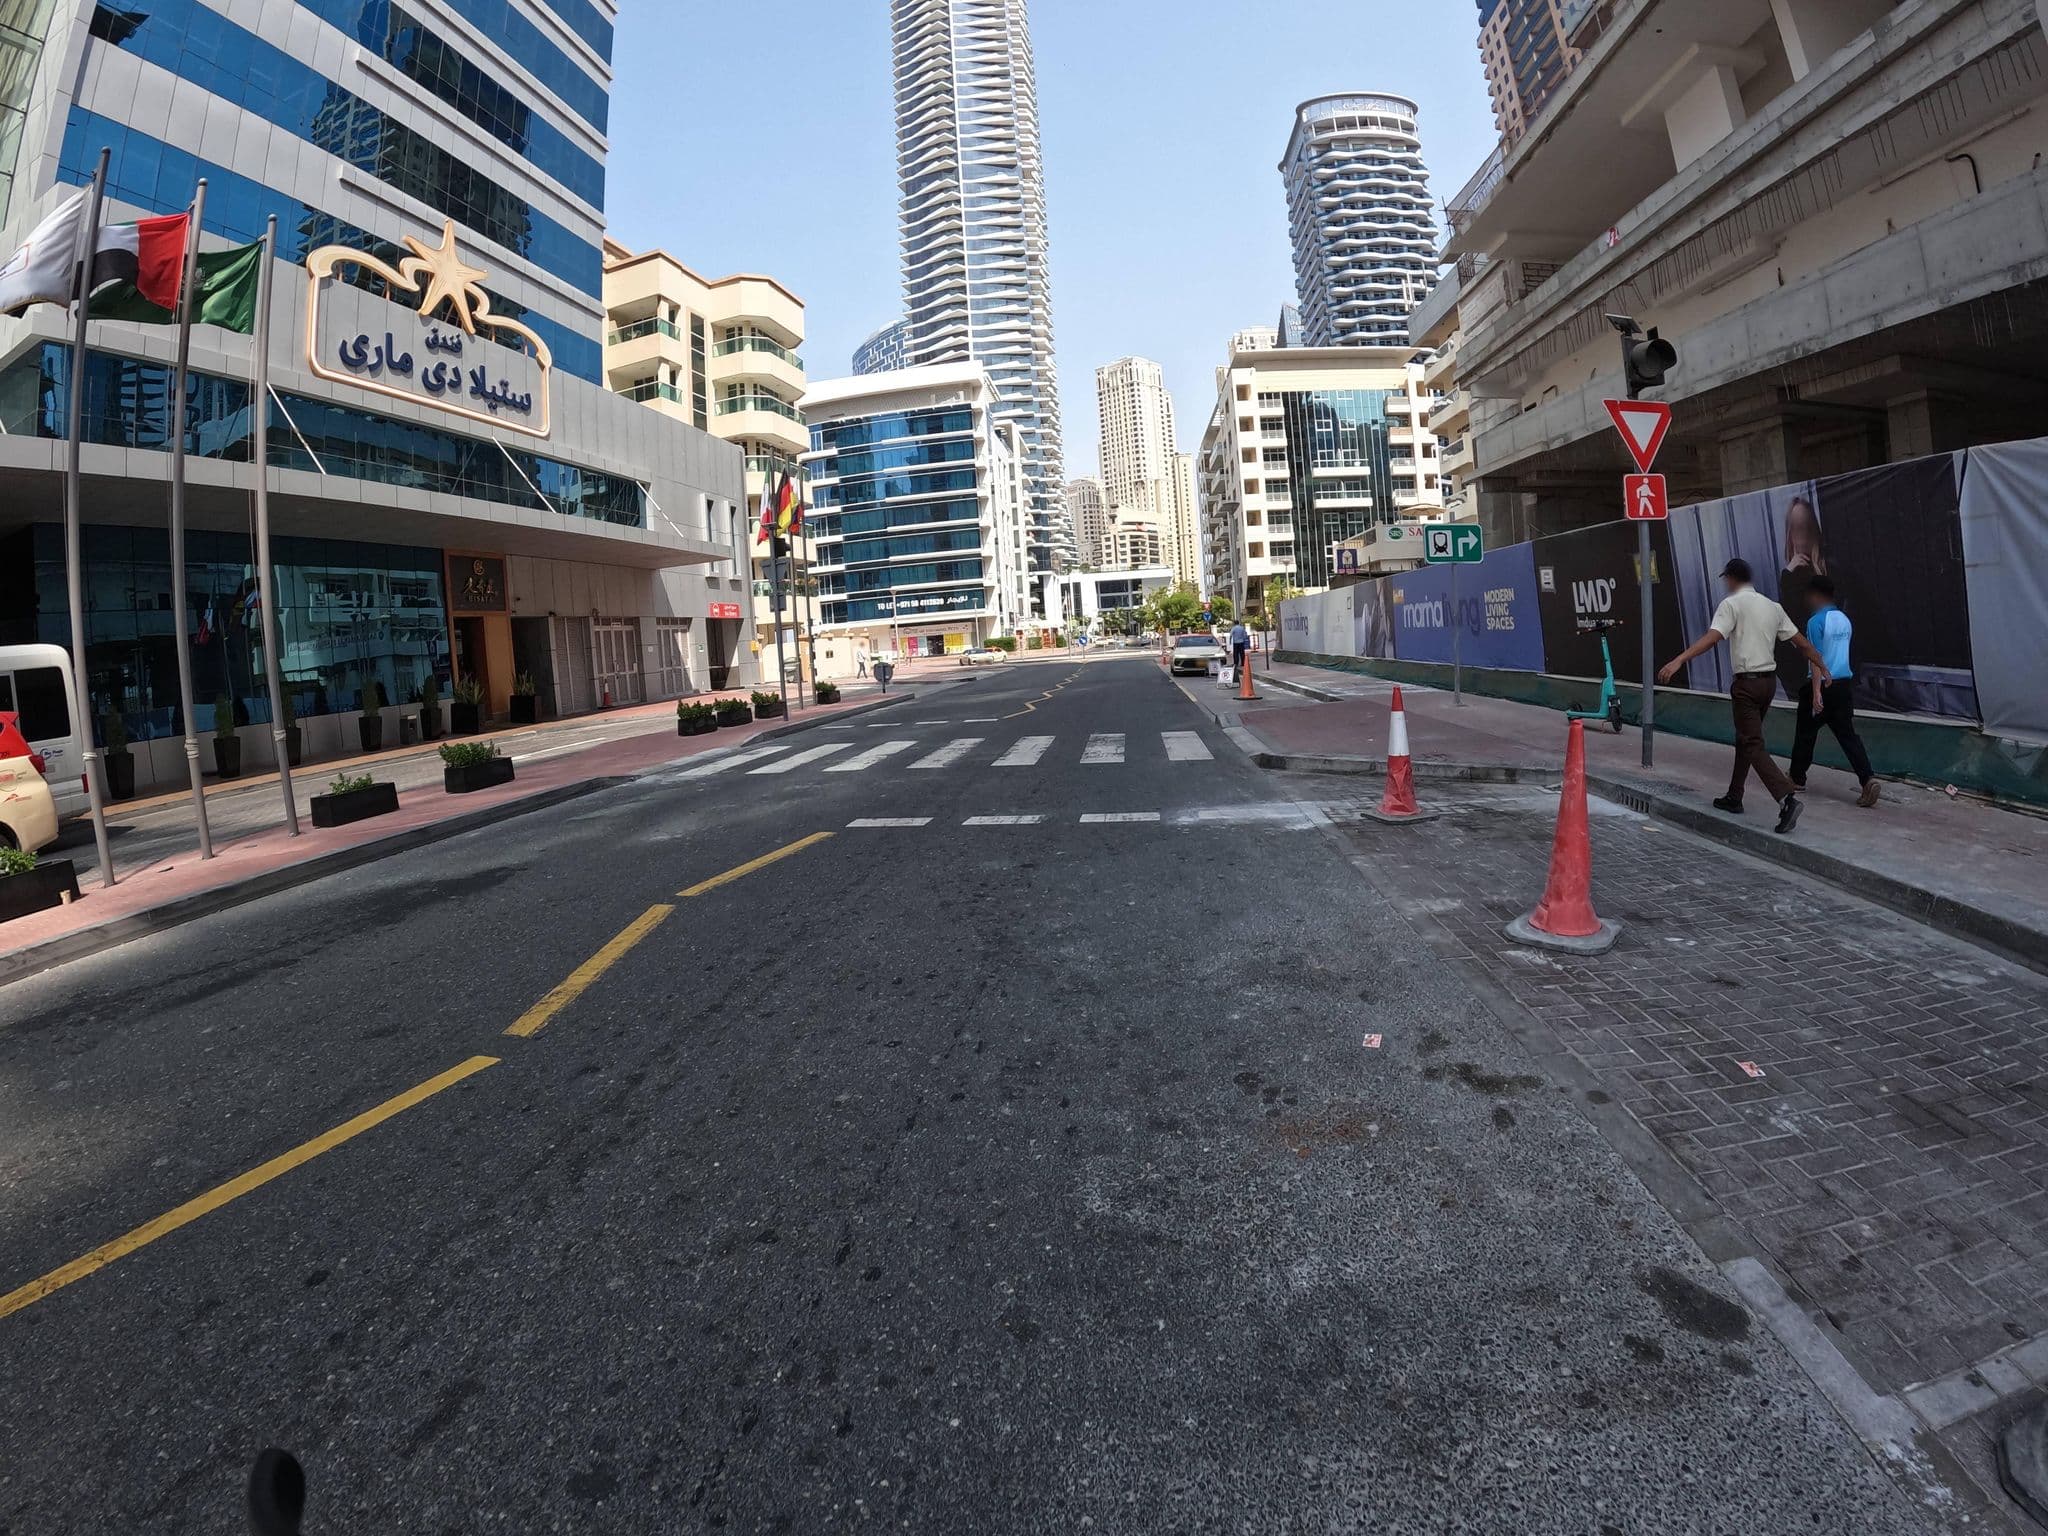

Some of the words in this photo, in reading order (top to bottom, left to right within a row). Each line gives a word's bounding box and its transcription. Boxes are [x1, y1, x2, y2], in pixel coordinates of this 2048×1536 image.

[424, 328, 463, 352] فندق
[469, 364, 532, 413] ستيلا
[1484, 588, 1514, 602] MODERN
[1485, 603, 1509, 616] LIVING
[1487, 616, 1515, 631] SPACES
